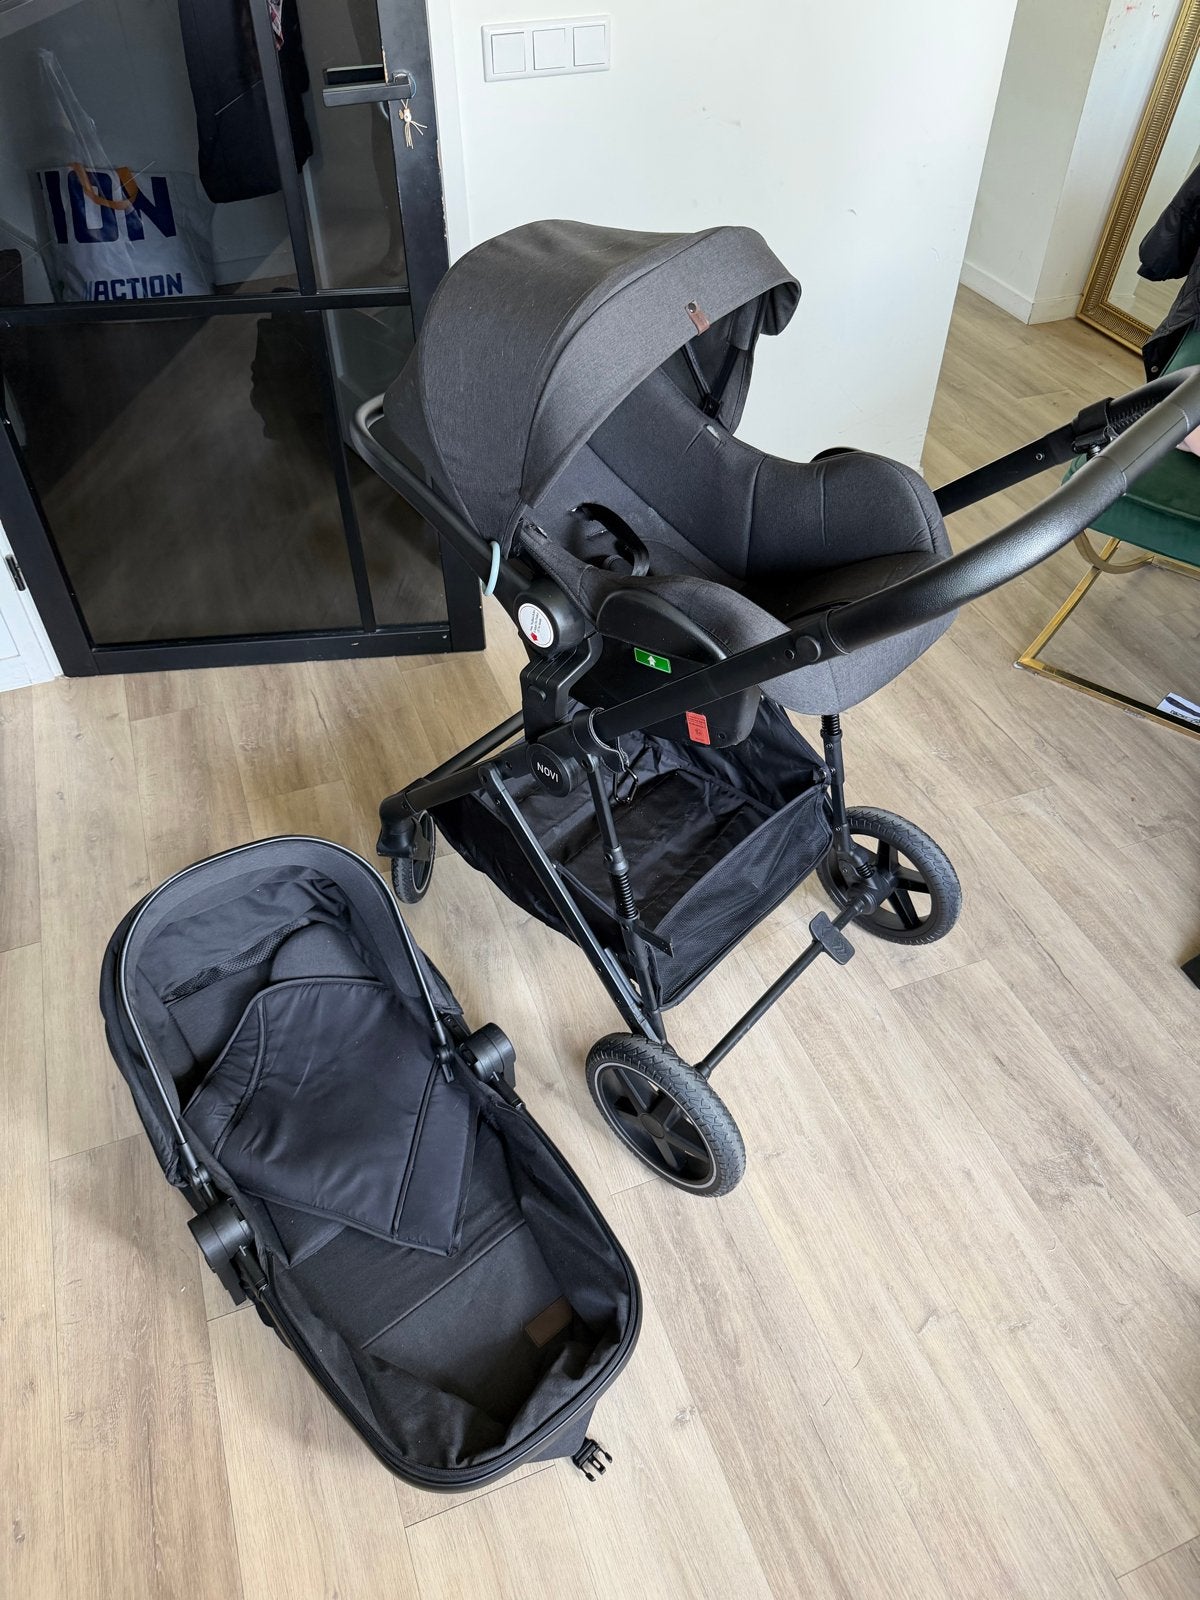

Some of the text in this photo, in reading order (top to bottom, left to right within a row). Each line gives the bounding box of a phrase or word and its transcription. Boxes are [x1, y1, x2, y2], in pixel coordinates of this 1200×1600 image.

[37, 170, 177, 244] ION
[94, 272, 183, 300] ACTION
[536, 761, 559, 783] NOVI
